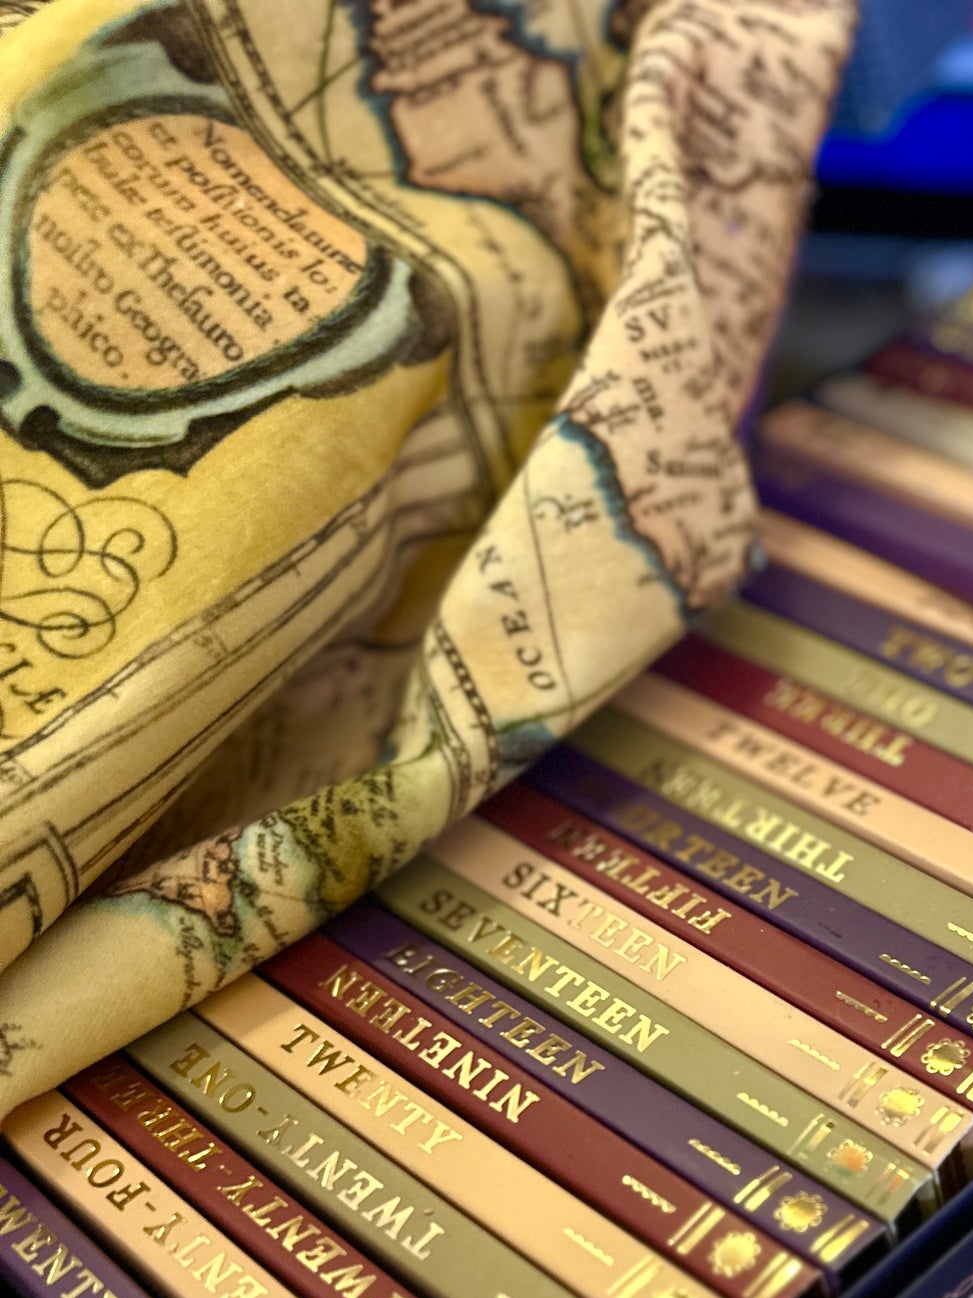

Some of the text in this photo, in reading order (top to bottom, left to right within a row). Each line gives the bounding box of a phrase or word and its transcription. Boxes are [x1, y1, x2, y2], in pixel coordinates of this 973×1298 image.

[704, 721, 882, 818] TWELVE
[765, 677, 915, 768] THREE
[549, 819, 732, 936] FIFTEEN
[612, 801, 799, 911] URTEEN
[639, 757, 855, 884] THIRTEEN
[421, 889, 670, 1054] SEVENTEEN
[502, 860, 687, 983] SIXTEEN
[318, 963, 541, 1124] NINETEEN
[383, 942, 606, 1085] EIGHTEEN
[280, 1023, 463, 1155] TWENTY
